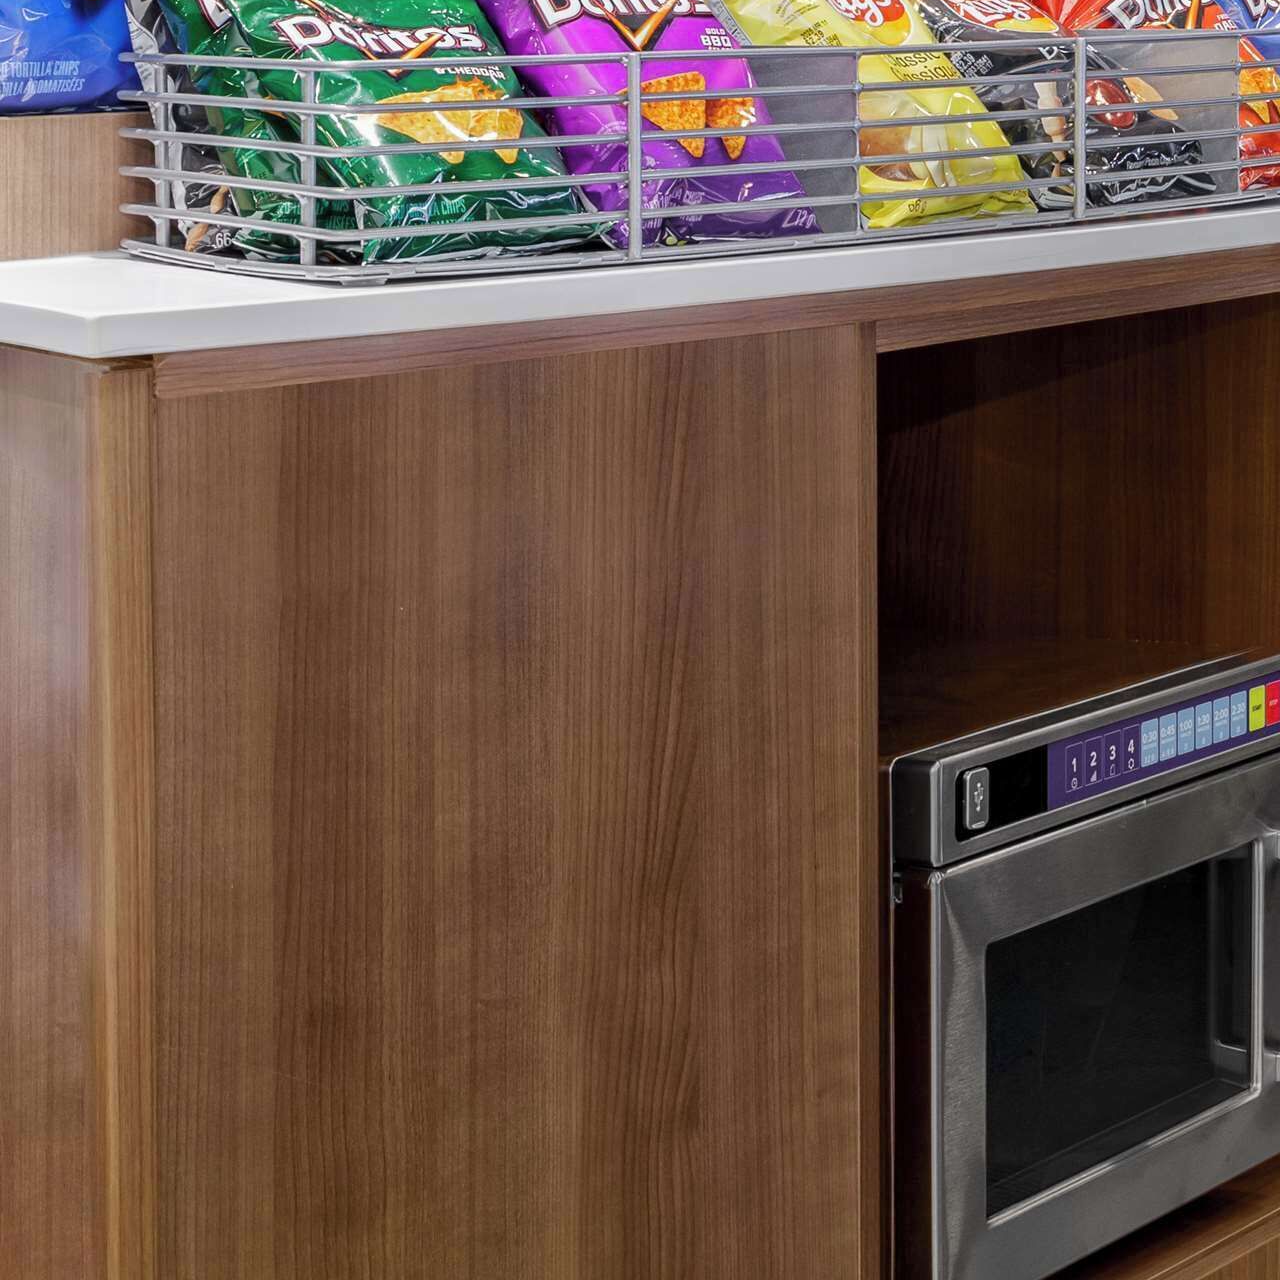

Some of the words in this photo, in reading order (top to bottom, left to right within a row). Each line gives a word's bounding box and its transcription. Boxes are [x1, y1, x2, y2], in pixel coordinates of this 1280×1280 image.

[278, 15, 485, 54] Doritos
[11, 61, 52, 78] TORTILLA
[53, 61, 81, 77] CHIPS
[441, 199, 466, 216] CHIPS
[215, 232, 232, 248] 66
[1213, 708, 1229, 722] 2:00
[1179, 719, 1193, 732] 1:00
[1109, 745, 1116, 760] 3
[1127, 739, 1135, 754] 4
[1071, 757, 1077, 773] 1
[1090, 751, 1097, 767] 2
